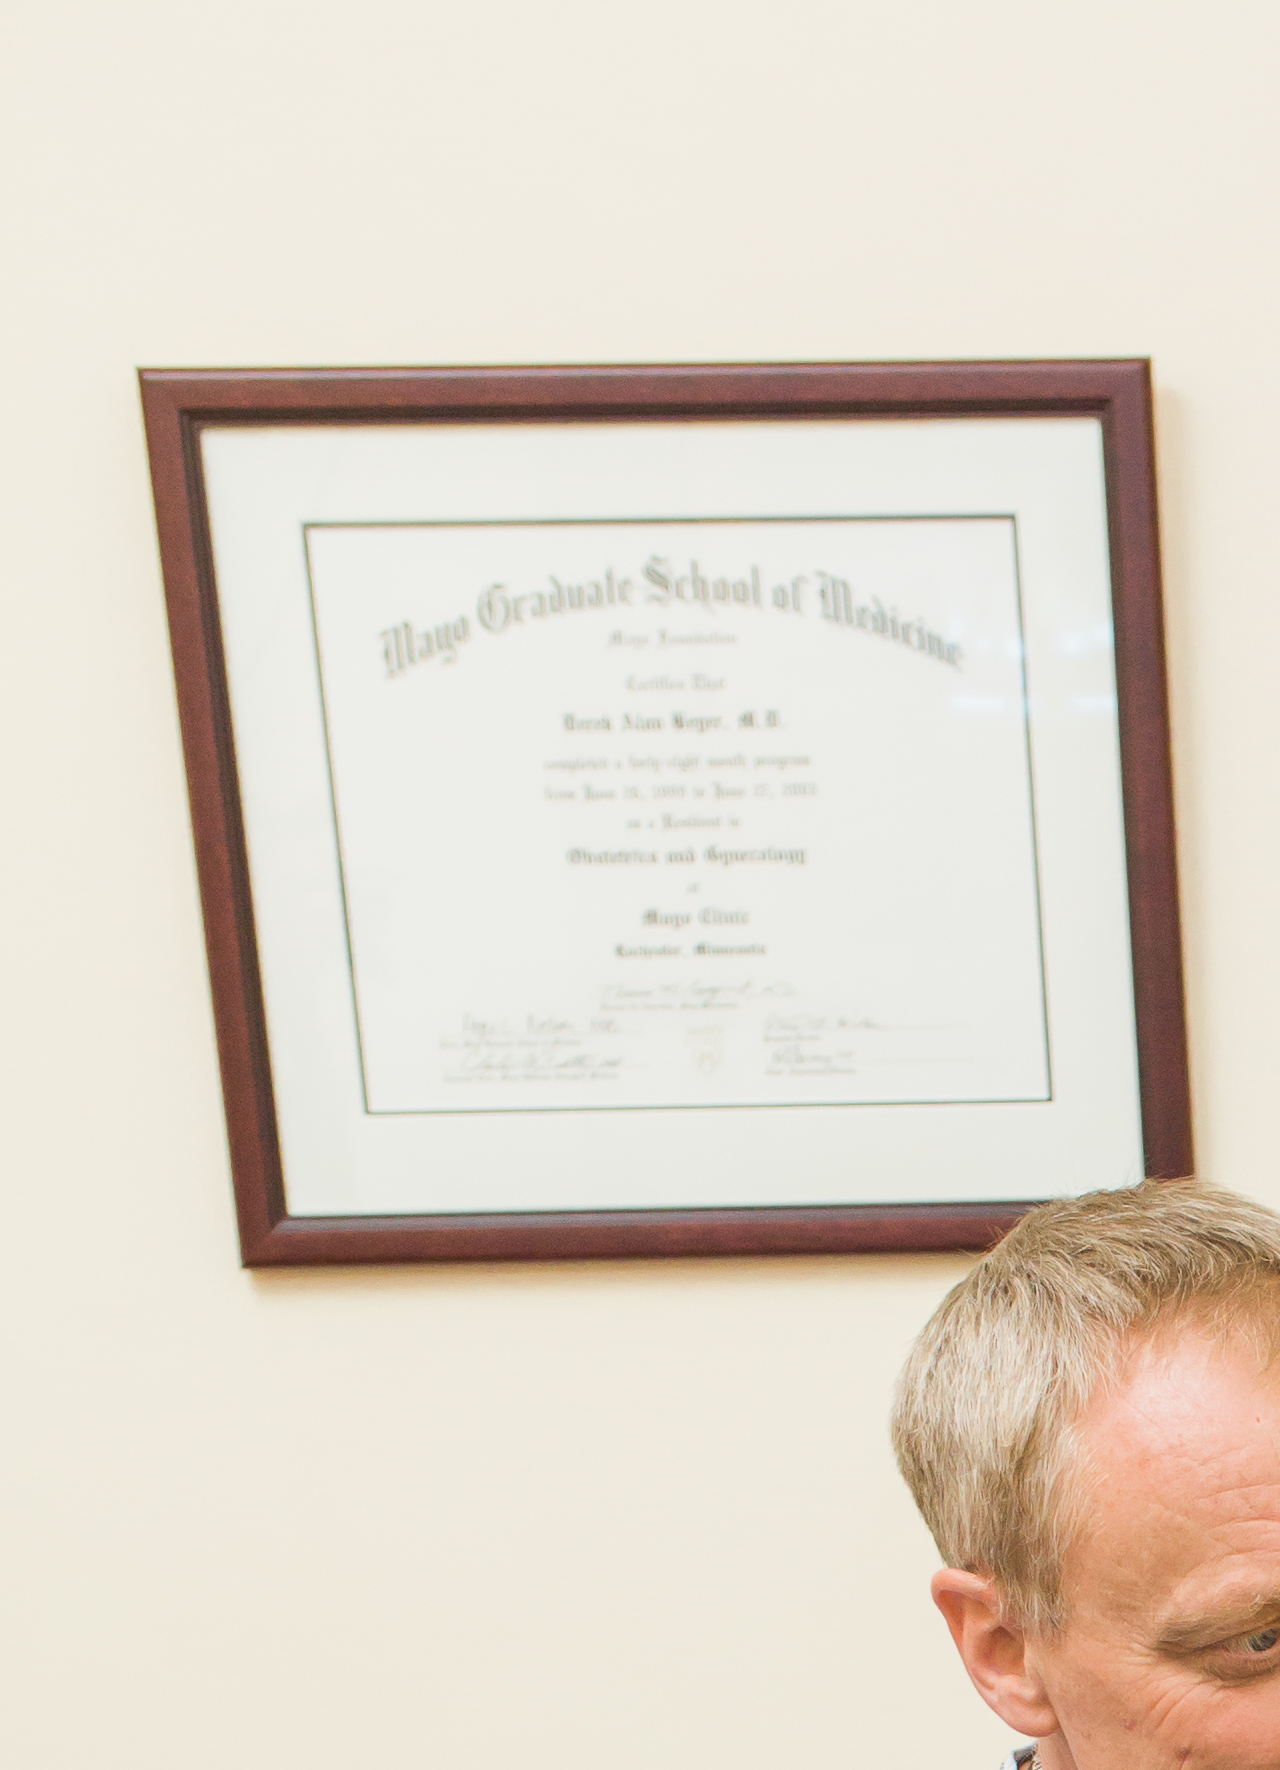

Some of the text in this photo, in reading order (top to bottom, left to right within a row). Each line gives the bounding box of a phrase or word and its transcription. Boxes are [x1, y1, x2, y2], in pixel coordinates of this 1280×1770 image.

[379, 554, 964, 680] Mayo Graduate School of Medicine
